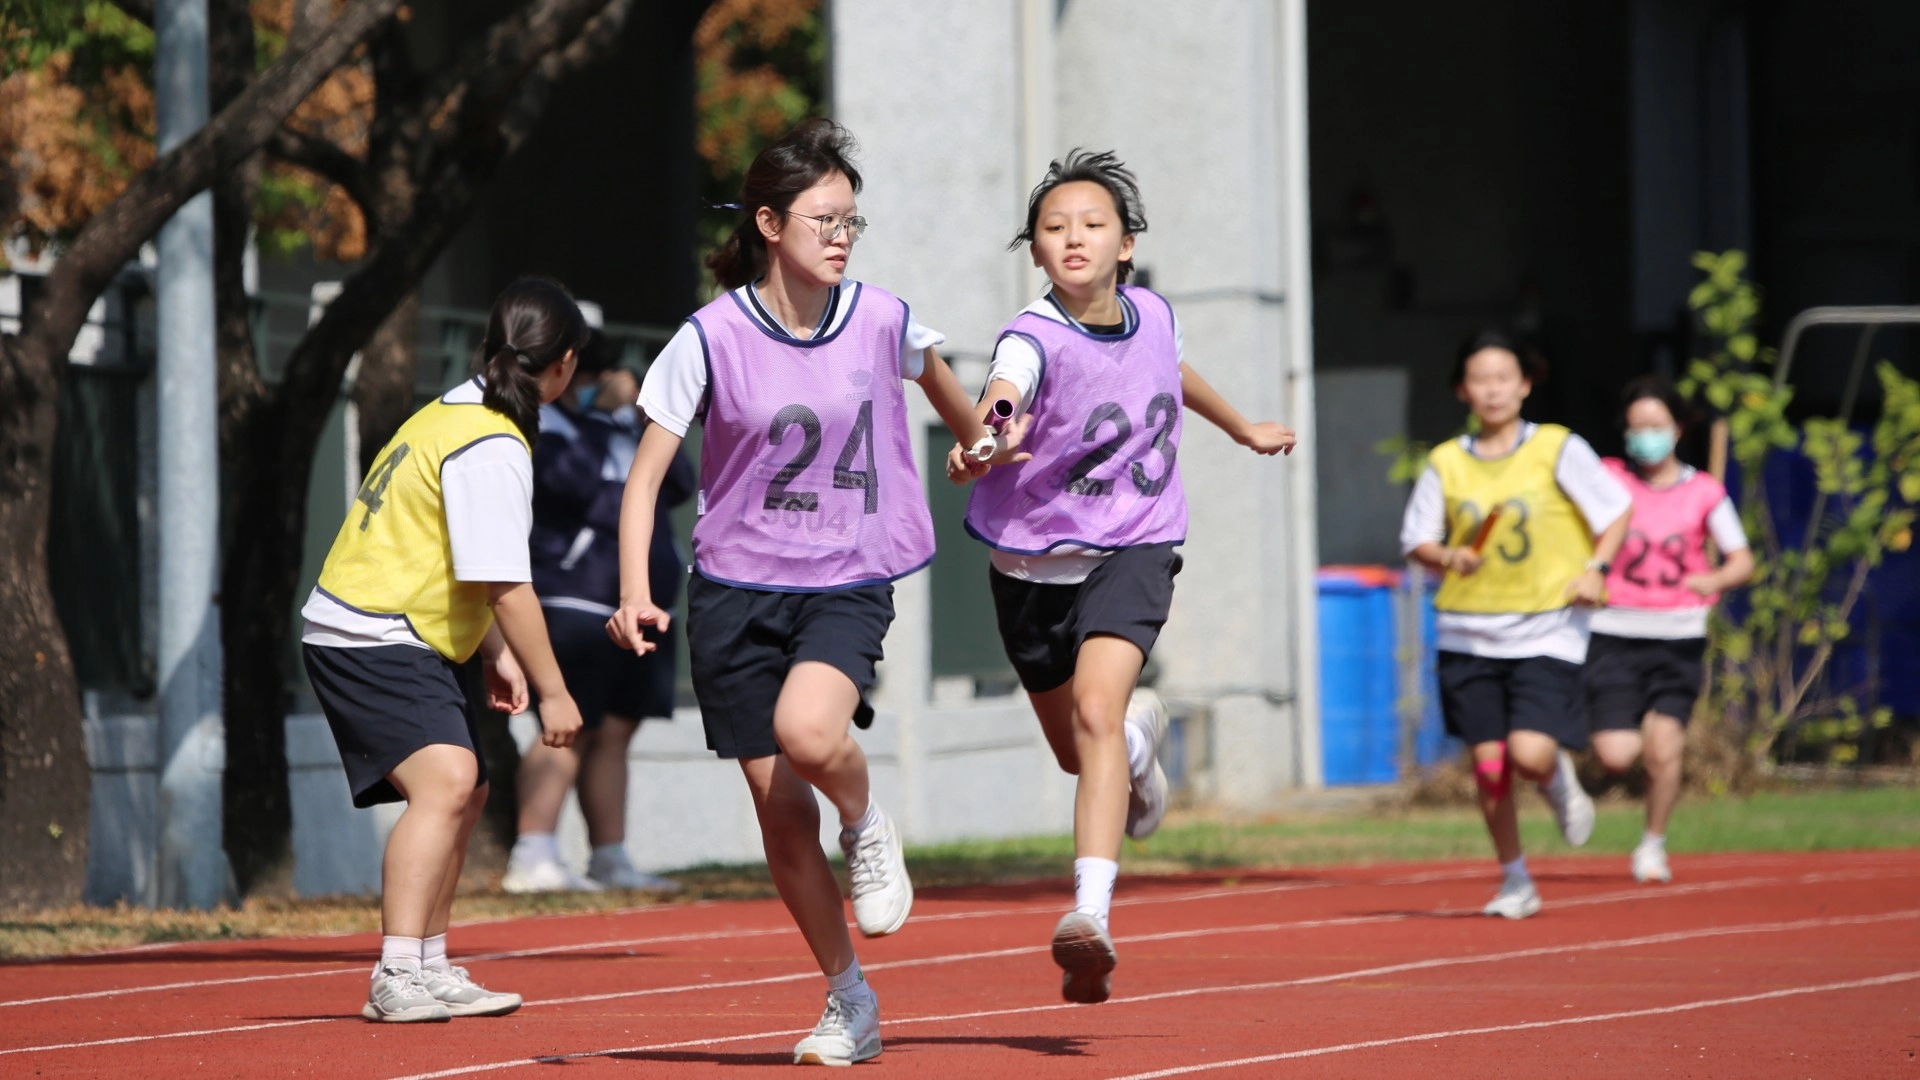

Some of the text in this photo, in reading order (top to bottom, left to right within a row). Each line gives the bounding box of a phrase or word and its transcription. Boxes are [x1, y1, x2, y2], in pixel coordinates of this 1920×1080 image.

[357, 441, 411, 532] 4
[763, 400, 878, 514] 24
[1064, 392, 1177, 497] 23
